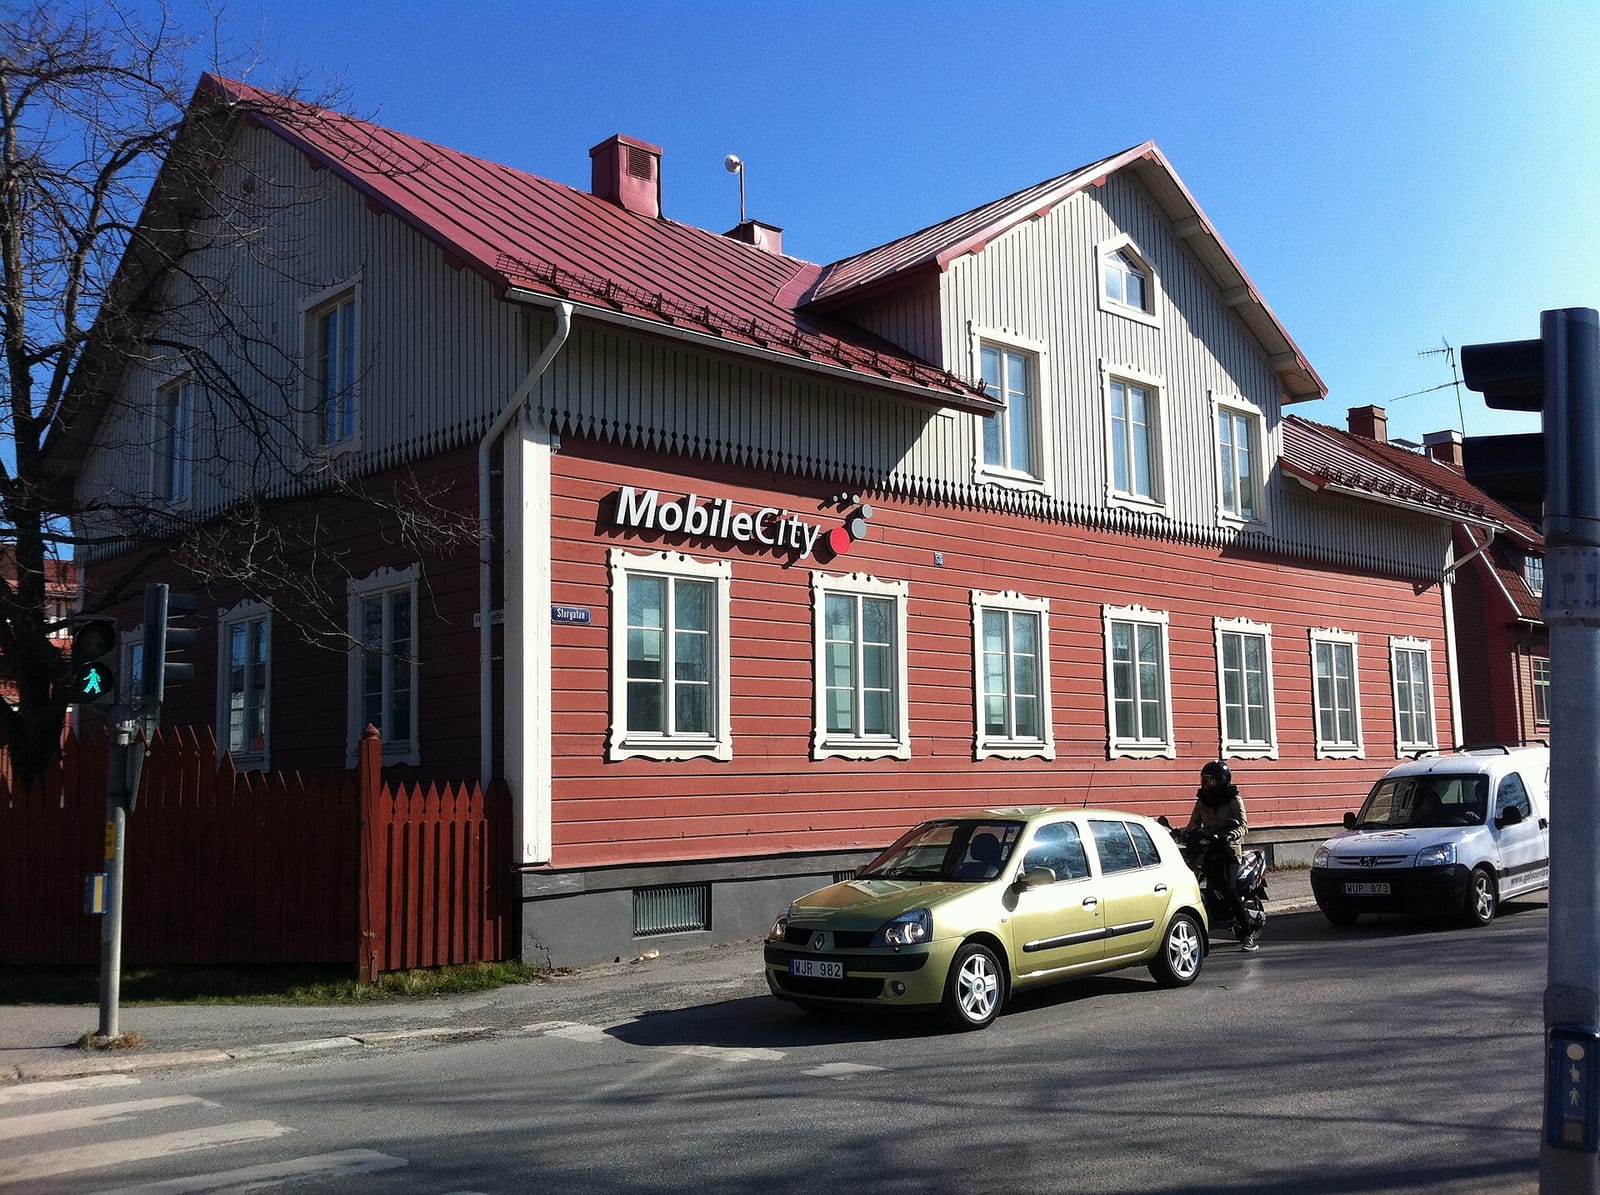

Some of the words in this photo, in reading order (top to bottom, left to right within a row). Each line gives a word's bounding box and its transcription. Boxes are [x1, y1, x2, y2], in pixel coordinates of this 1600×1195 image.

[616, 485, 822, 559] MobileCity
[794, 960, 813, 976] WJR
[819, 962, 841, 978] 982
